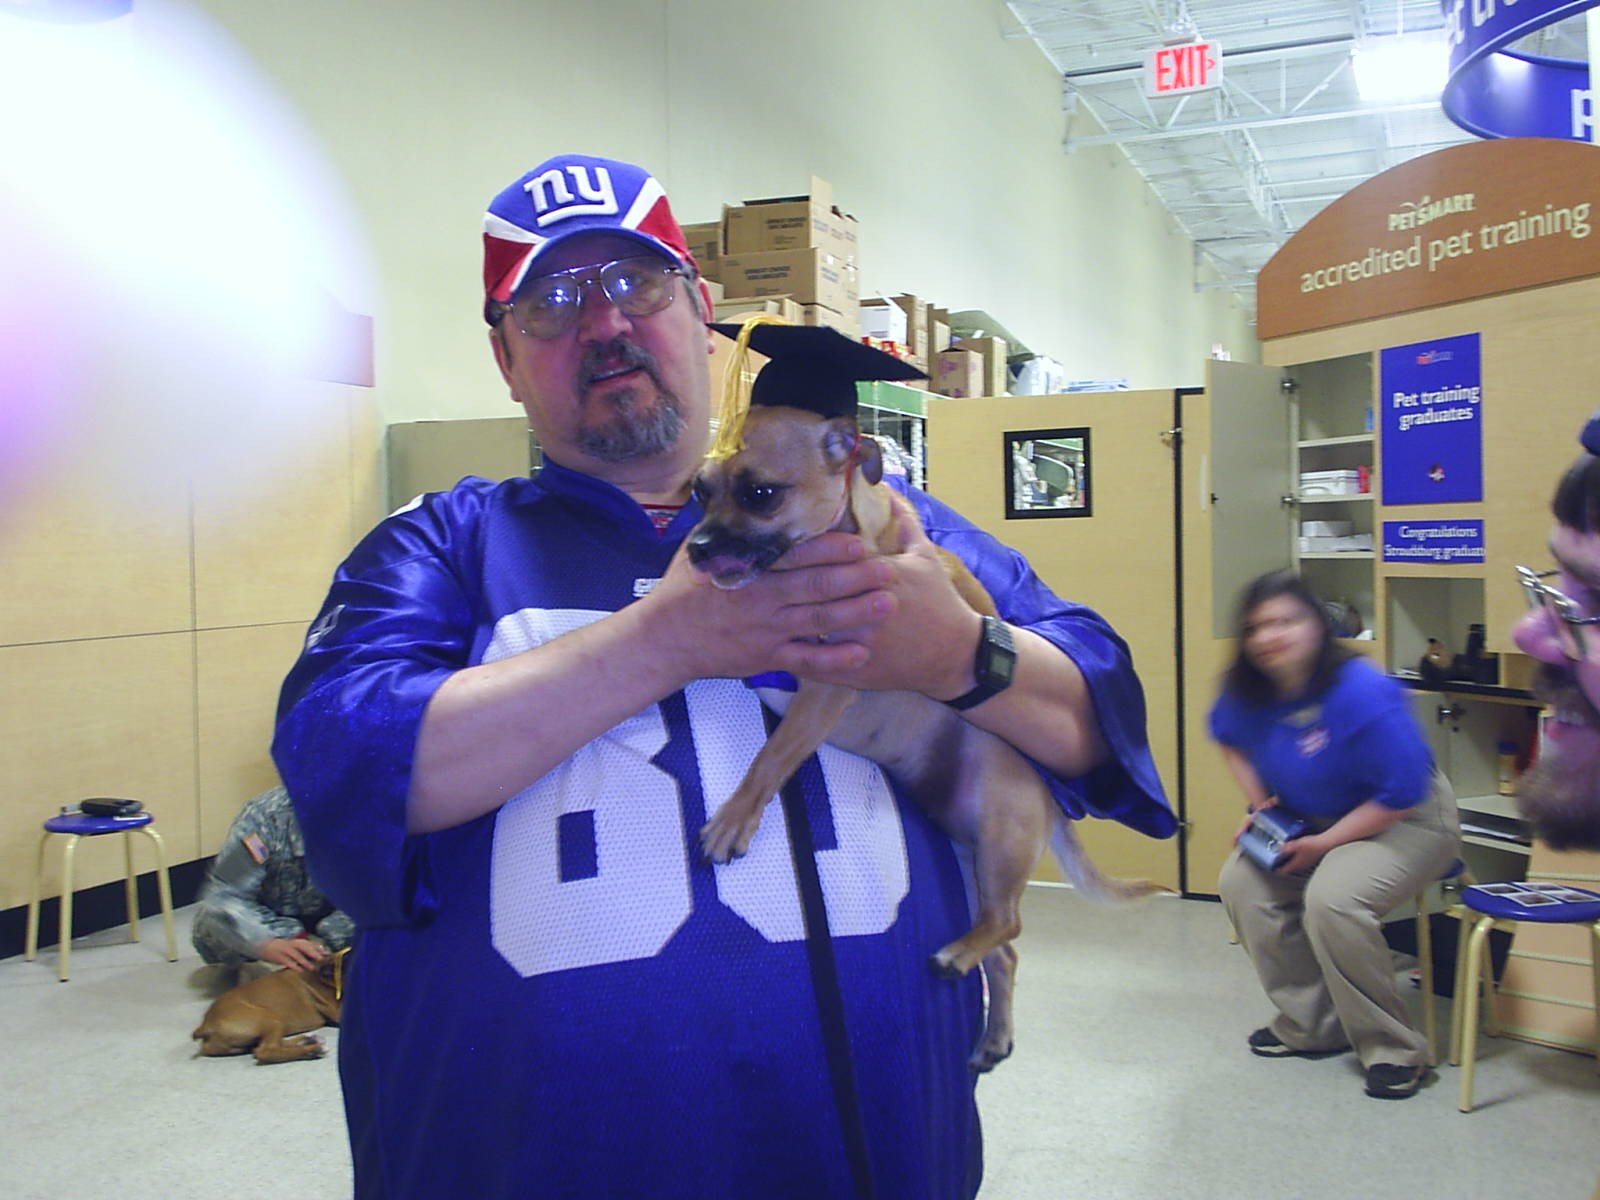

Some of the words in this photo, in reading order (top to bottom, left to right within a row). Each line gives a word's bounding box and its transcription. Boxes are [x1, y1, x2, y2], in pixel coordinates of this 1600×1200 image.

[1155, 44, 1210, 92] EXIT
[1300, 236, 1421, 293] accredited
[1428, 229, 1474, 272] pet
[1479, 202, 1592, 251] training
[1393, 392, 1419, 408] Pet
[1421, 384, 1480, 404] training
[1399, 407, 1473, 431] graduates
